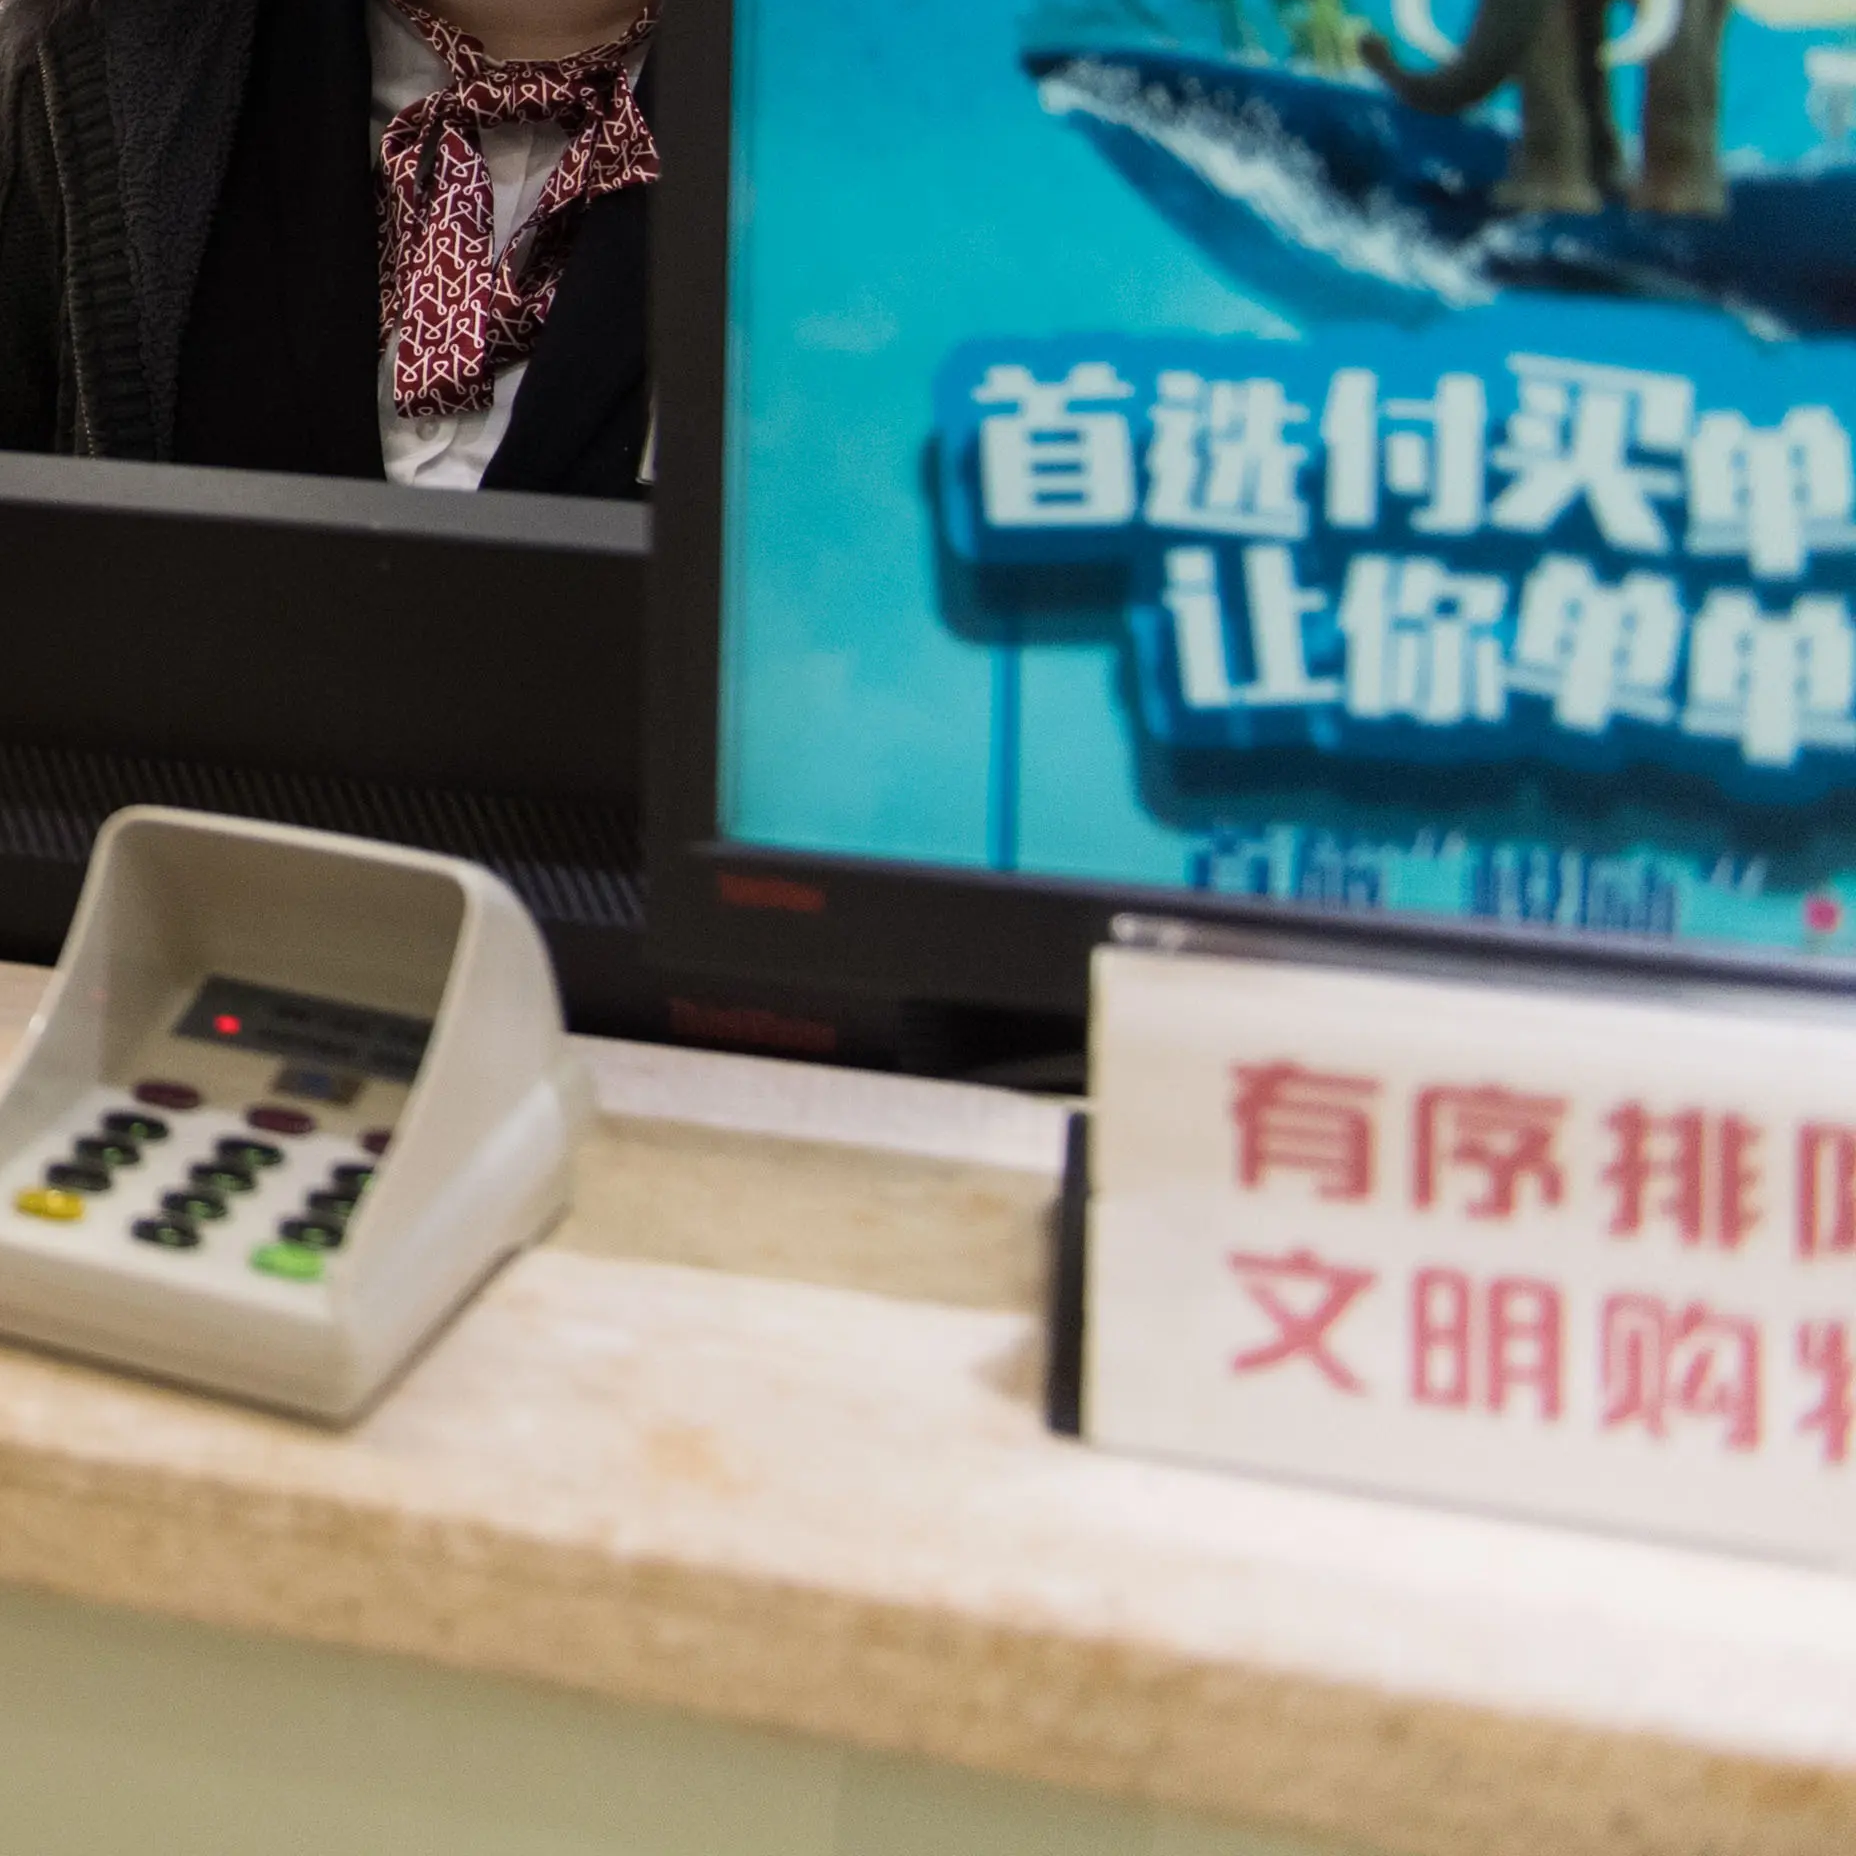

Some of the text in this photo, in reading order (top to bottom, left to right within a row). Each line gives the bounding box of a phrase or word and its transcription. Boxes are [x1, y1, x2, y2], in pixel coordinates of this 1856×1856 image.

[970, 351, 1856, 581] 首选付买单
[1163, 544, 1856, 768] 让你单单
